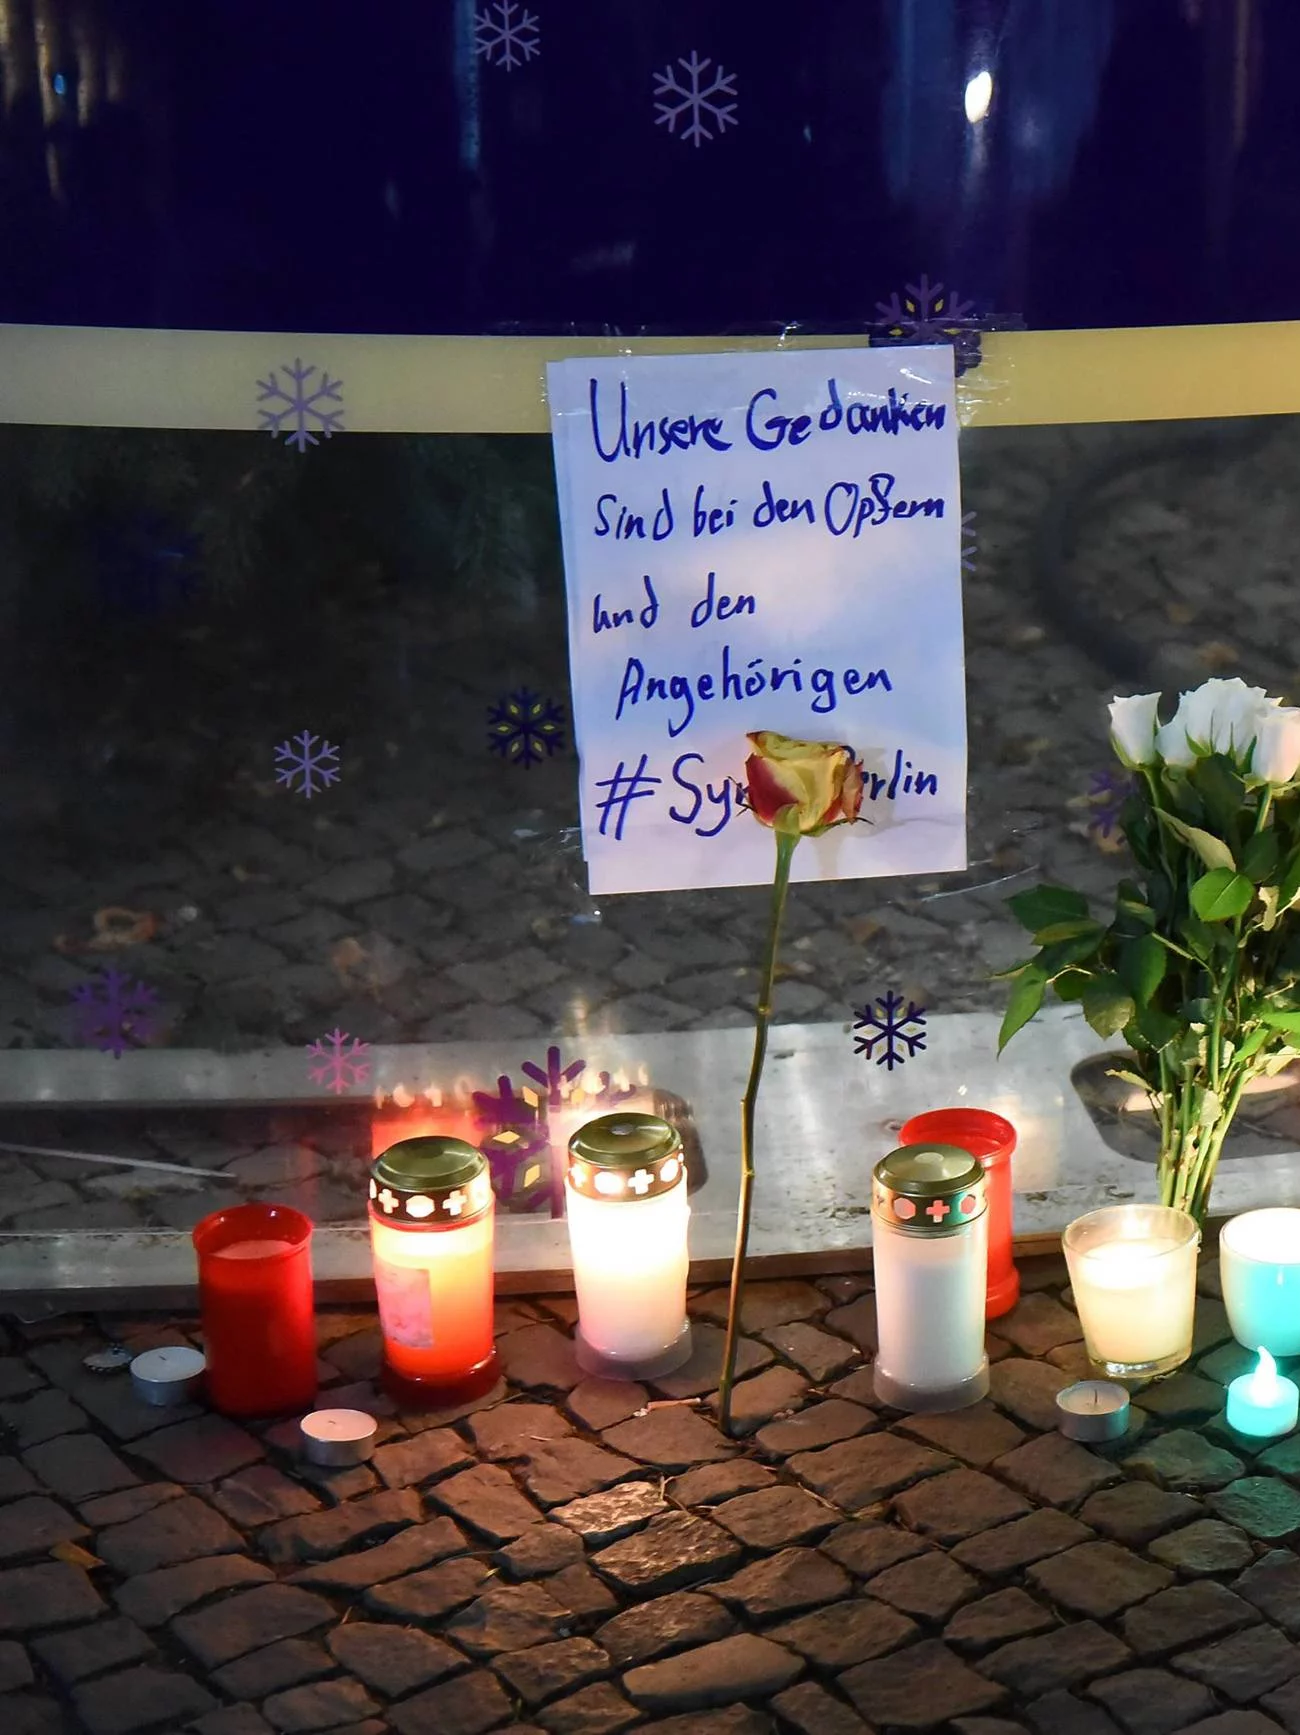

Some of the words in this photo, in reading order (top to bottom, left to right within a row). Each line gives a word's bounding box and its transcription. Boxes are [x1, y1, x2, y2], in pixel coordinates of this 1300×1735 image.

[589, 377, 733, 463] Unsere
[692, 484, 739, 538] bei
[752, 479, 815, 528] den
[690, 571, 756, 629] den
[614, 644, 893, 738] Angehörigen
